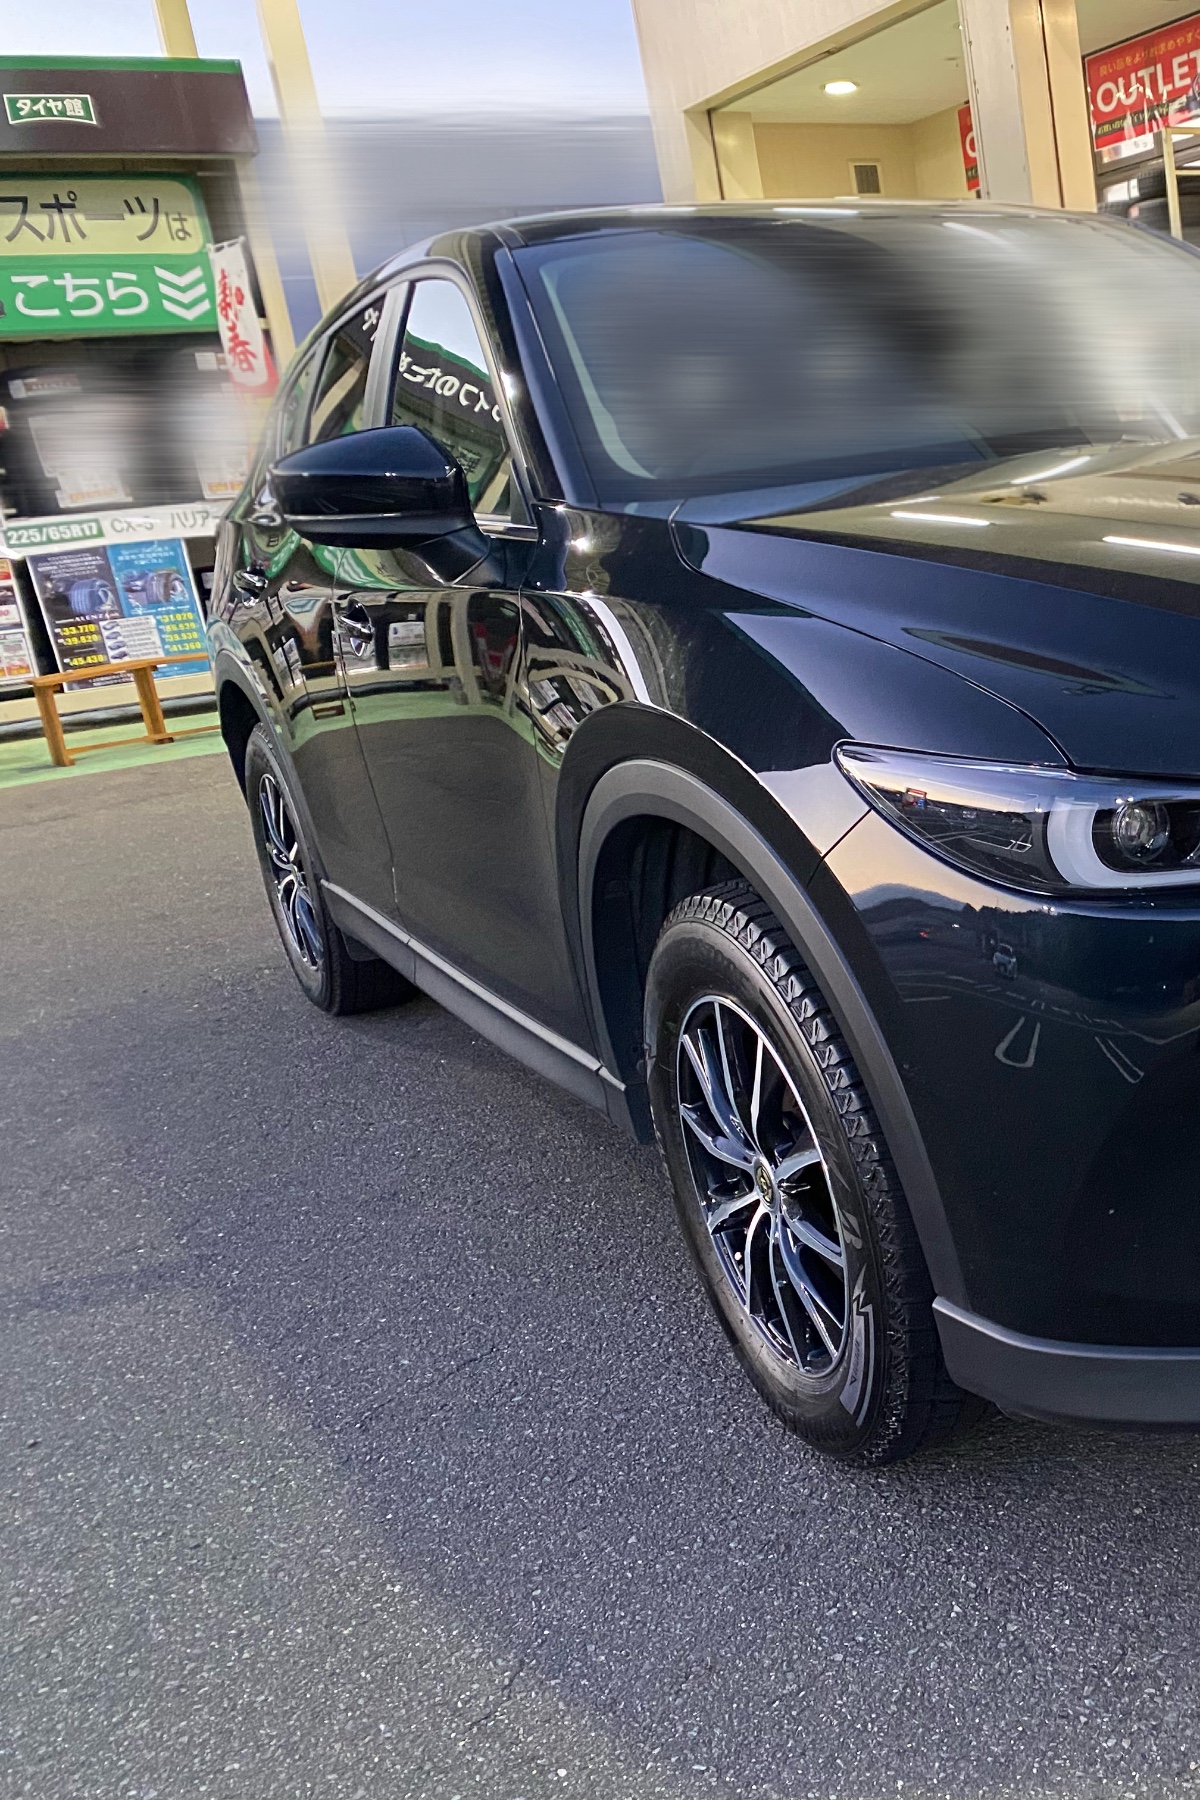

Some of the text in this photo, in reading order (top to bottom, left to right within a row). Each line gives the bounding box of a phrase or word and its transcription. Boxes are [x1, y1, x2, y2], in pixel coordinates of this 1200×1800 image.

[16, 98, 84, 117] タイヤ館
[0, 190, 192, 243] スポーツは
[11, 272, 149, 317] こちら
[8, 521, 98, 545] 225/65R17
